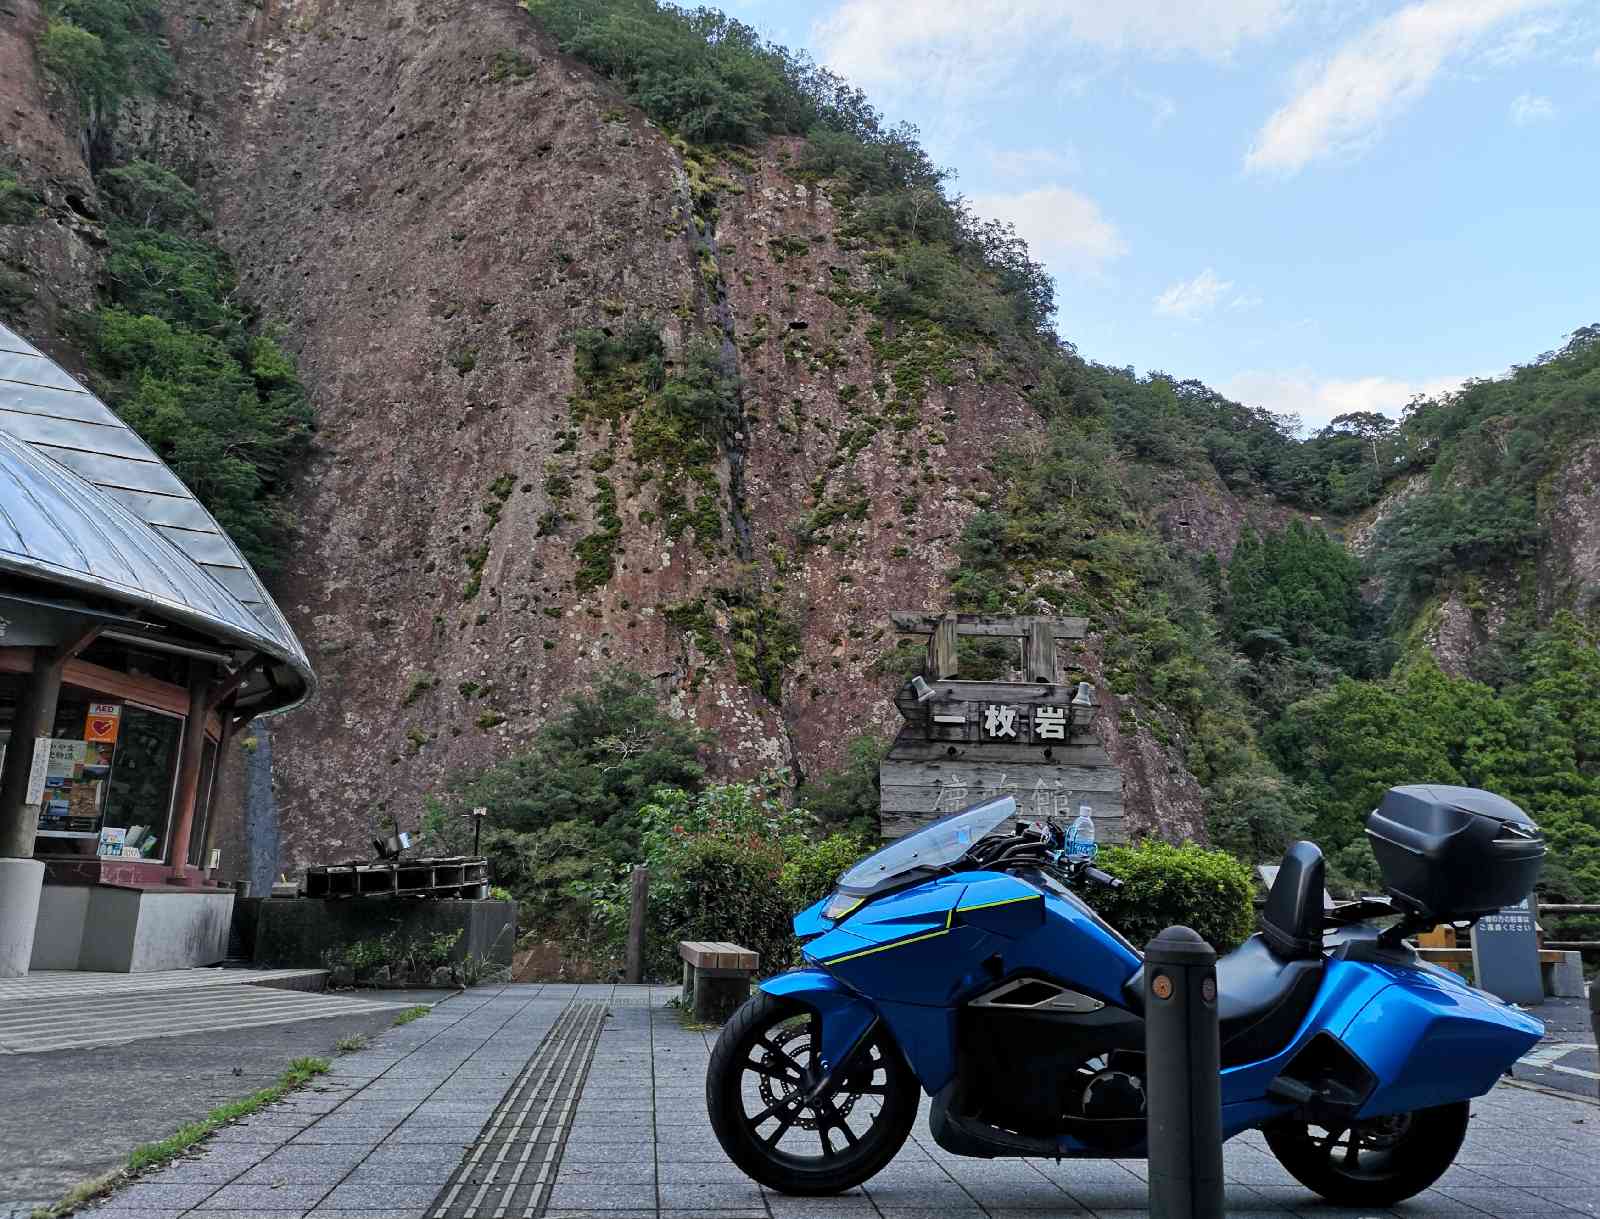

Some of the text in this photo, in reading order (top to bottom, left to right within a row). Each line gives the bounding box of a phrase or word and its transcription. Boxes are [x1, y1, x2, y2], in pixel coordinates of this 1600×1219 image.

[95, 704, 114, 713] AED
[933, 704, 1067, 740] 一枚岩
